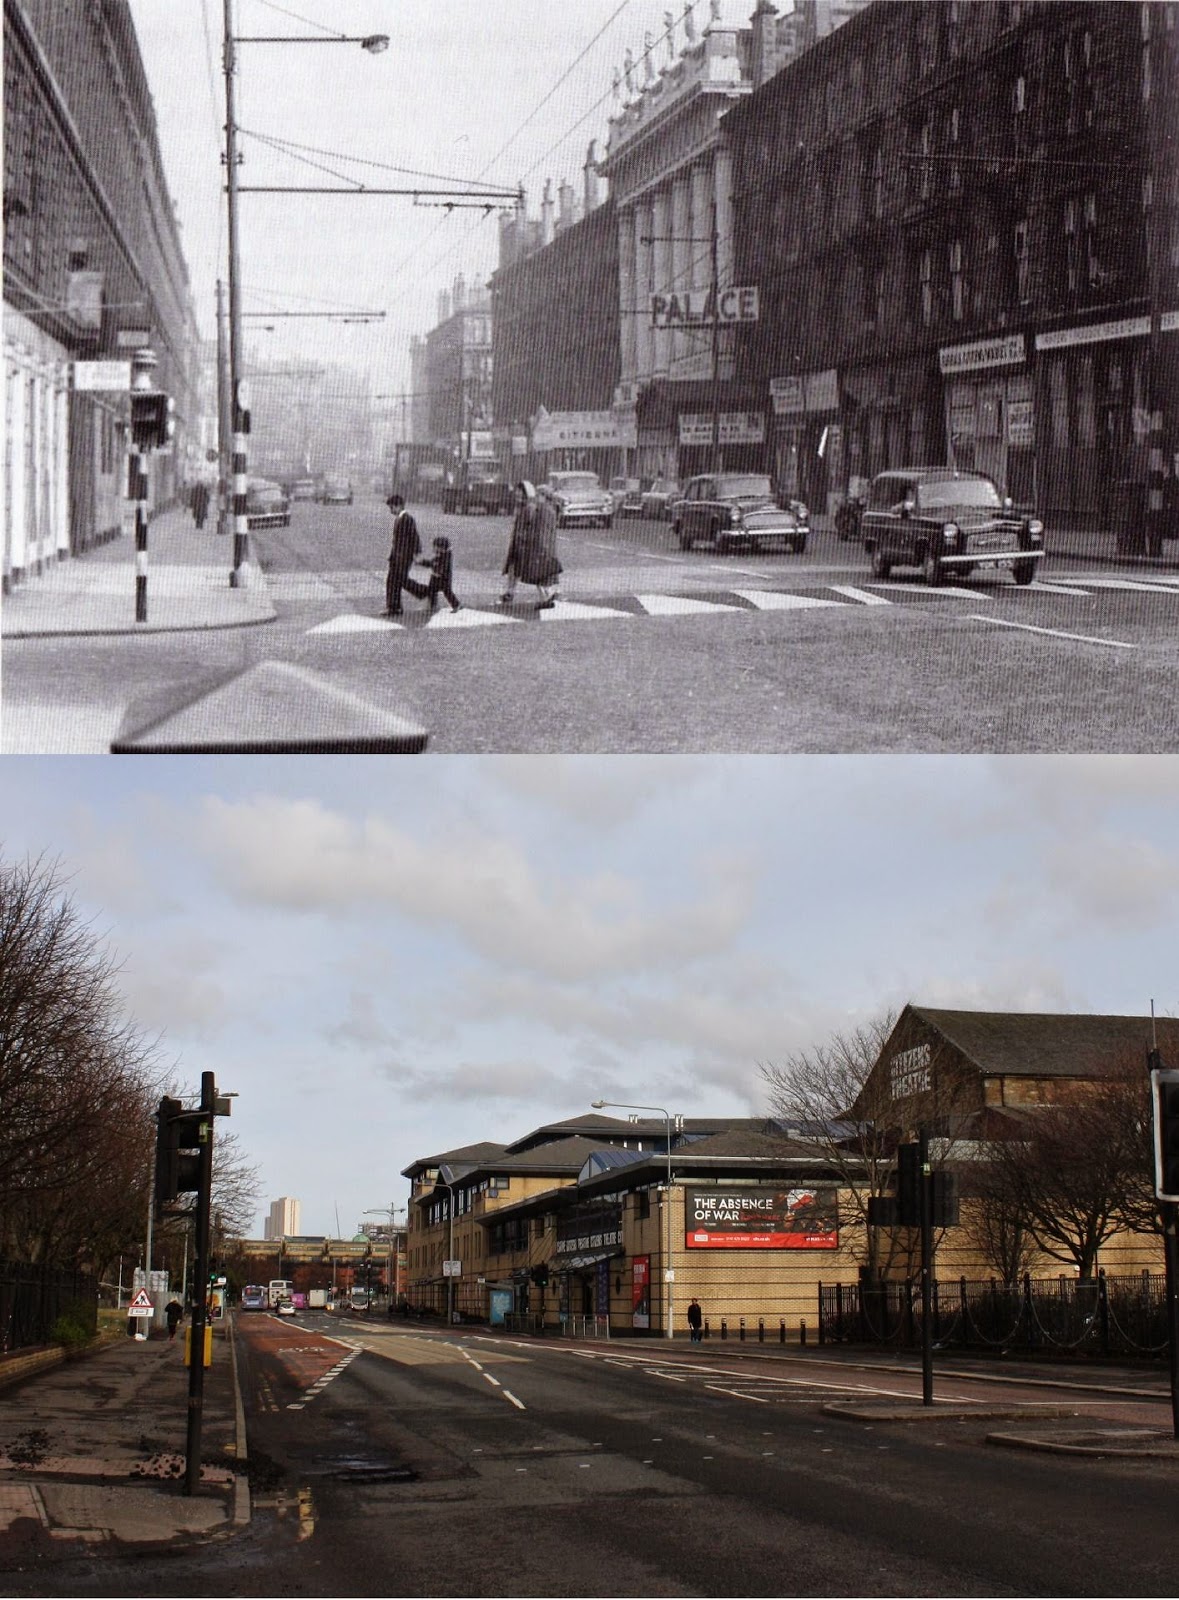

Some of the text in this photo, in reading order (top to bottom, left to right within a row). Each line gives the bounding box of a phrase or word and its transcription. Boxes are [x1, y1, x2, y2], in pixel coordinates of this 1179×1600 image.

[651, 290, 756, 323] PALACE
[694, 1198, 773, 1209] THE ABSENCE
[694, 1210, 711, 1220] OF
[713, 1210, 740, 1220] WAR
